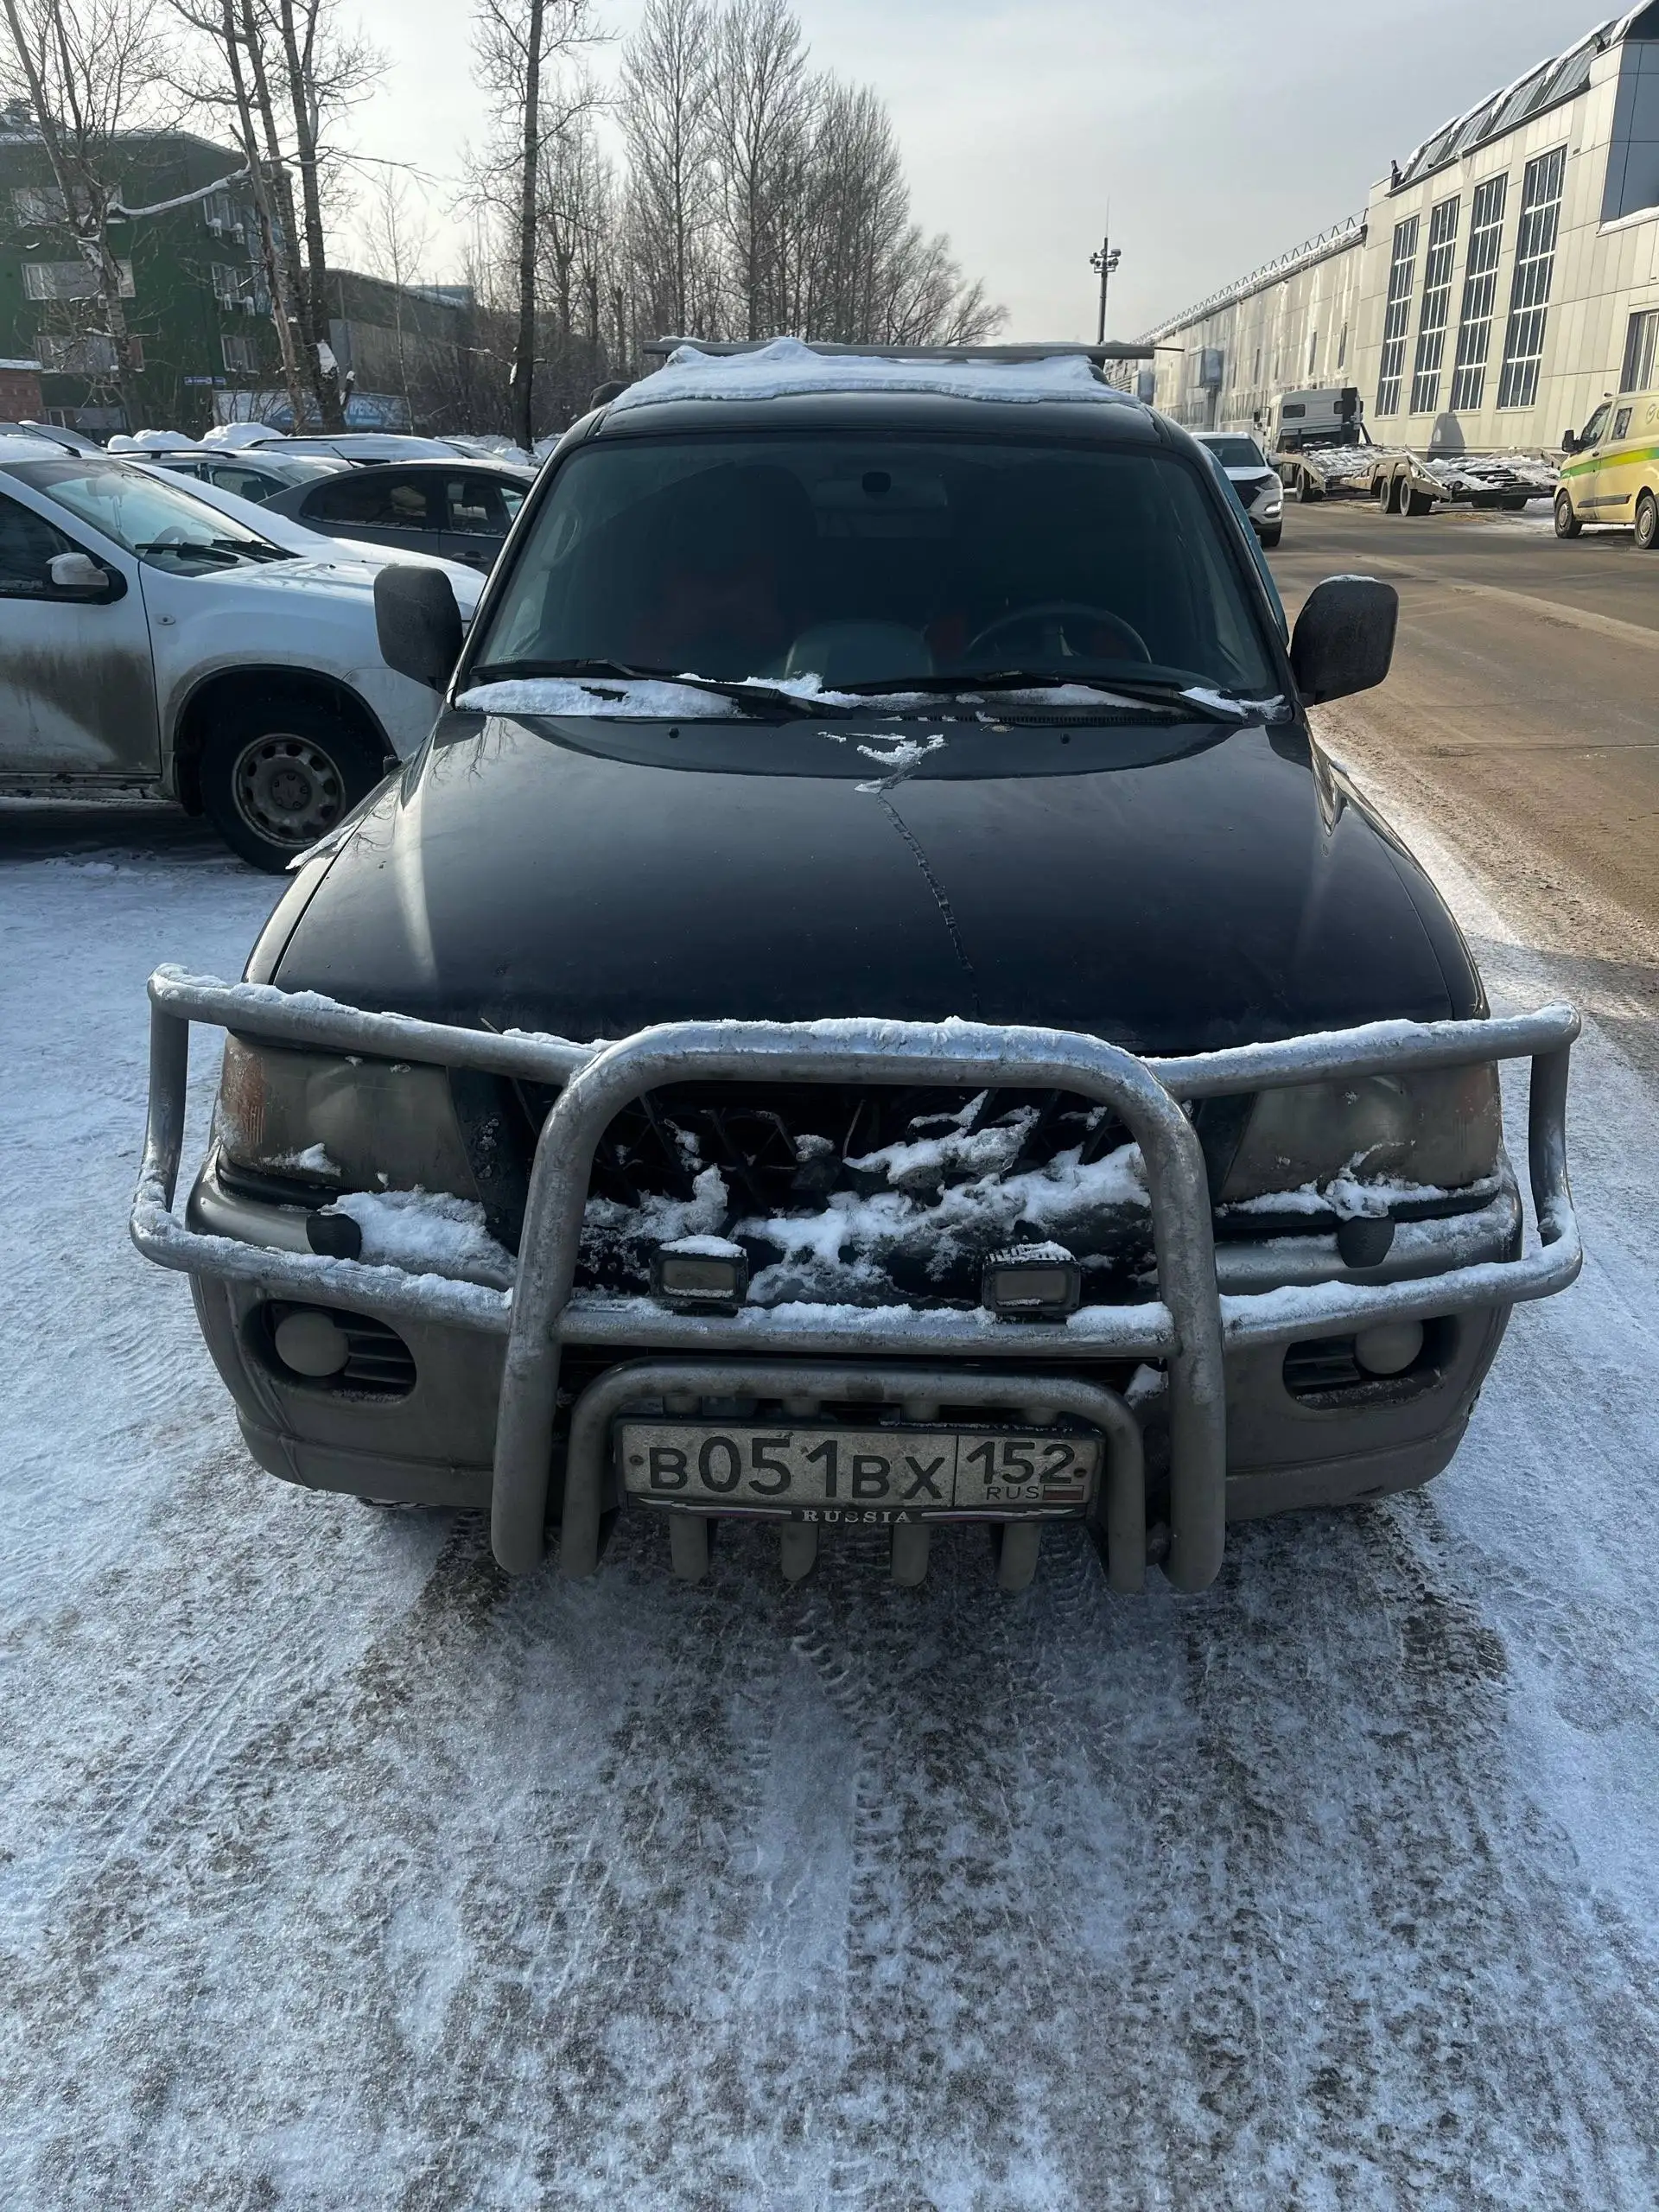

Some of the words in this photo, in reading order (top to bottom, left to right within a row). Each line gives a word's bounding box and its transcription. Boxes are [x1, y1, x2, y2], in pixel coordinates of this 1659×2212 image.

[966, 1440, 1075, 1484] 152
[986, 1485, 1039, 1501] RUS
[802, 1510, 912, 1523] RUSSIA
